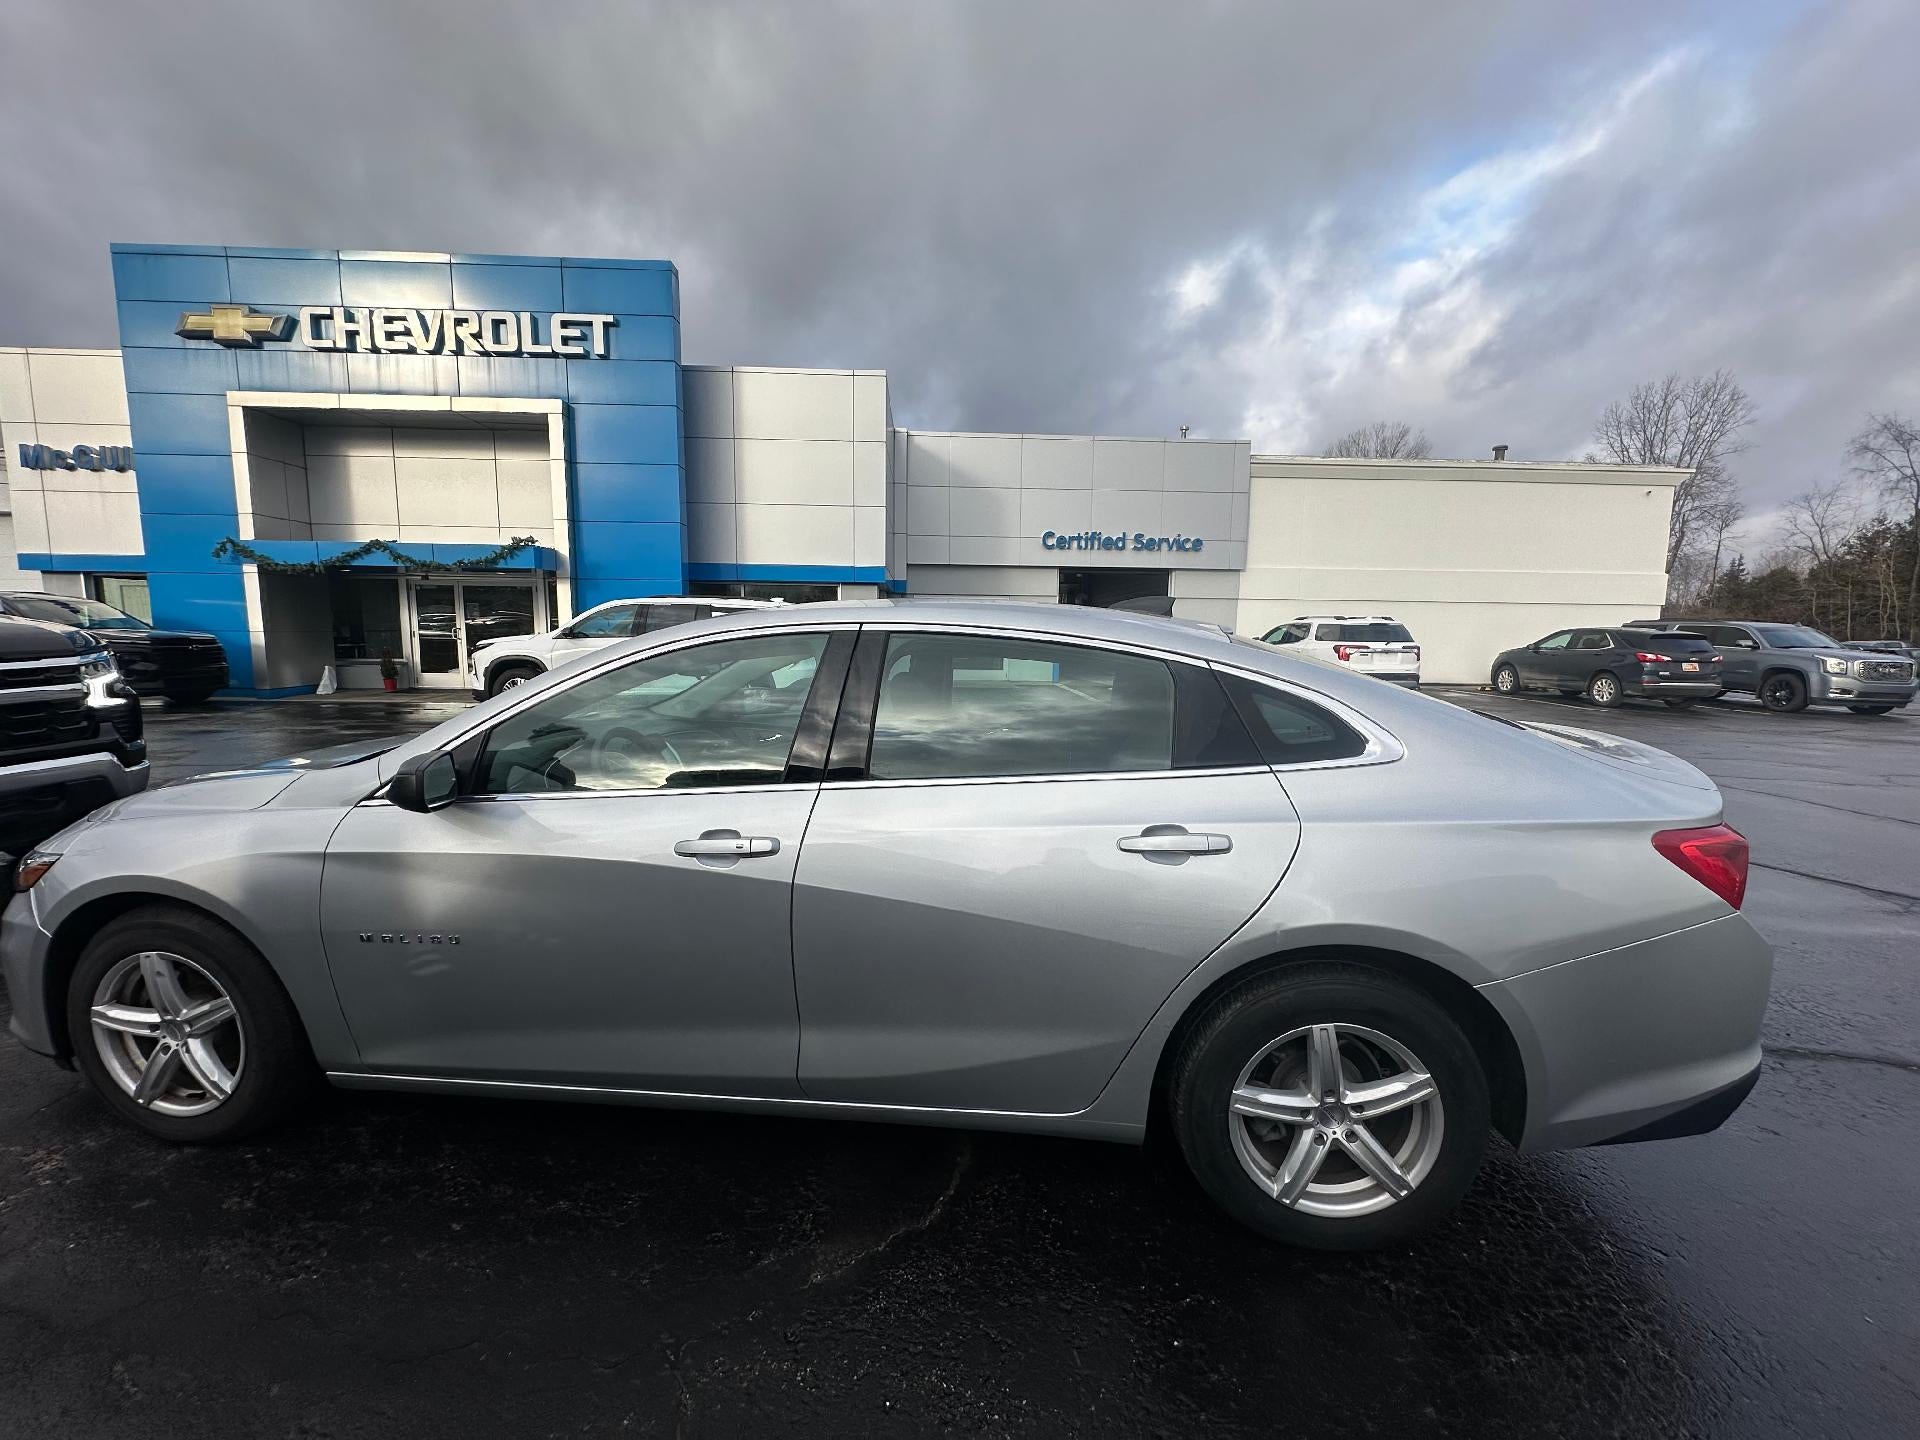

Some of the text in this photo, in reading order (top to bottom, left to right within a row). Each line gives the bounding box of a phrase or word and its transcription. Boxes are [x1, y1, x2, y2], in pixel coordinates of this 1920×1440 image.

[299, 306, 615, 357] CHEVROLET
[1042, 530, 1203, 552] Certified Service
[359, 933, 461, 945] MALIBU
